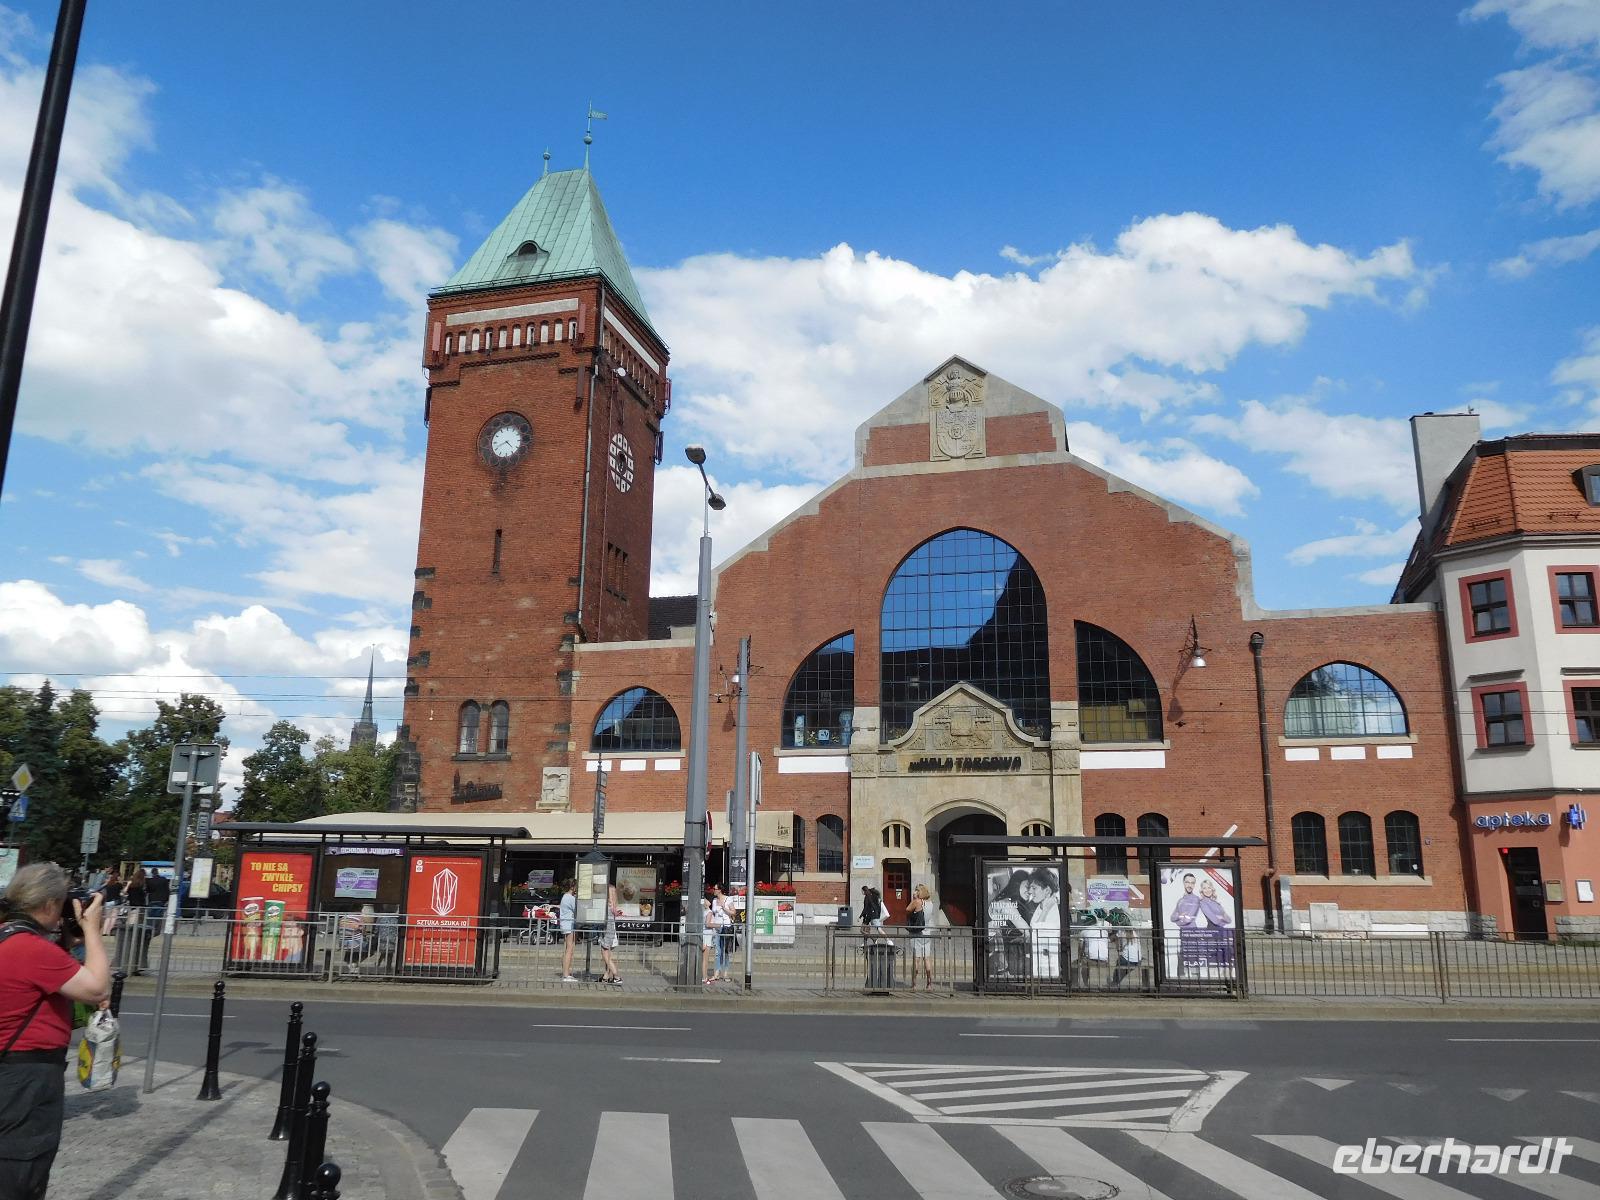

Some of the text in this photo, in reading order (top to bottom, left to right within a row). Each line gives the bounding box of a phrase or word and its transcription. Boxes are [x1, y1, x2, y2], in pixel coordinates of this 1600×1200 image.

[1476, 811, 1552, 830] apteka
[340, 847, 368, 855] OCHRONA
[250, 862, 261, 871] TO
[262, 862, 276, 871] NIE
[272, 883, 304, 893] CHIPSY
